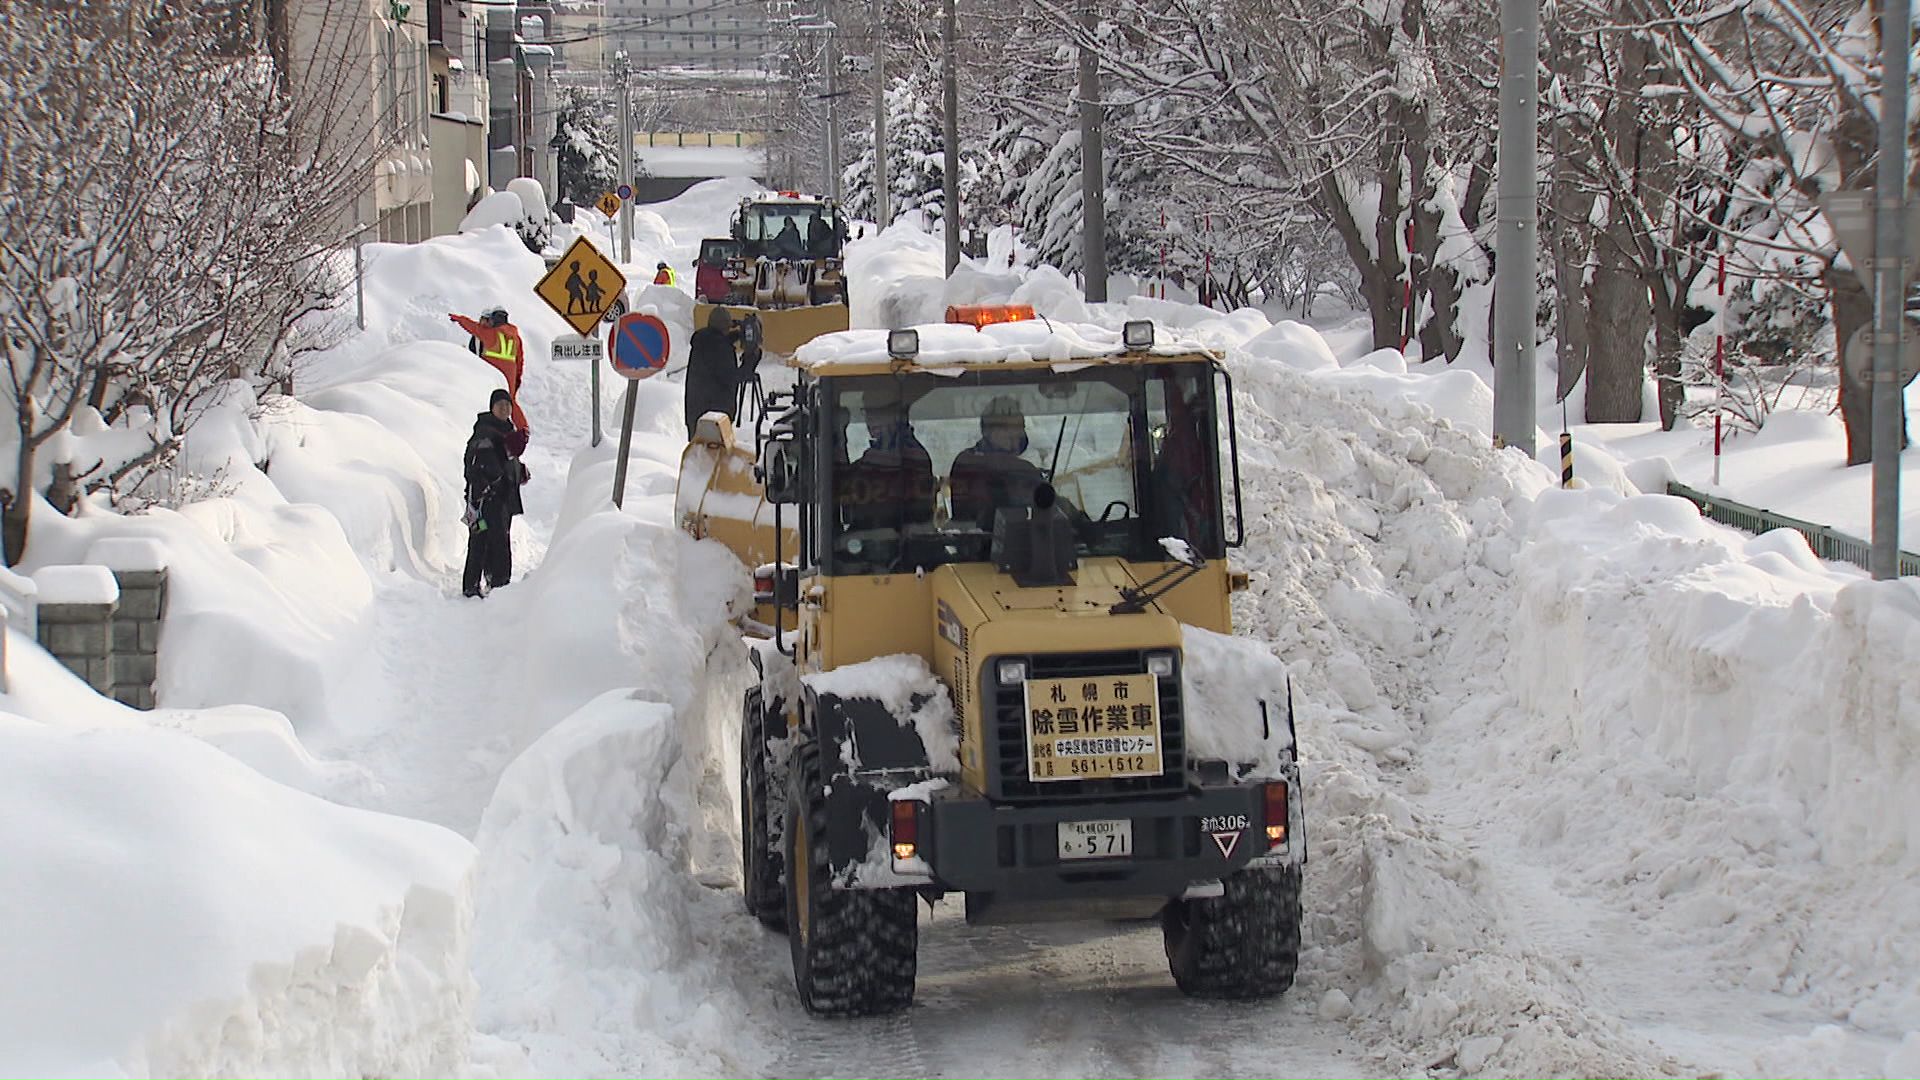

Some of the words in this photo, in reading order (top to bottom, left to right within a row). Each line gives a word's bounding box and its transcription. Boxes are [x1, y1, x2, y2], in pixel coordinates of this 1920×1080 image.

[1050, 681, 1129, 703] 札幌市
[1031, 703, 1153, 736] 除雪作業車
[1071, 757, 1144, 774] 561-1512
